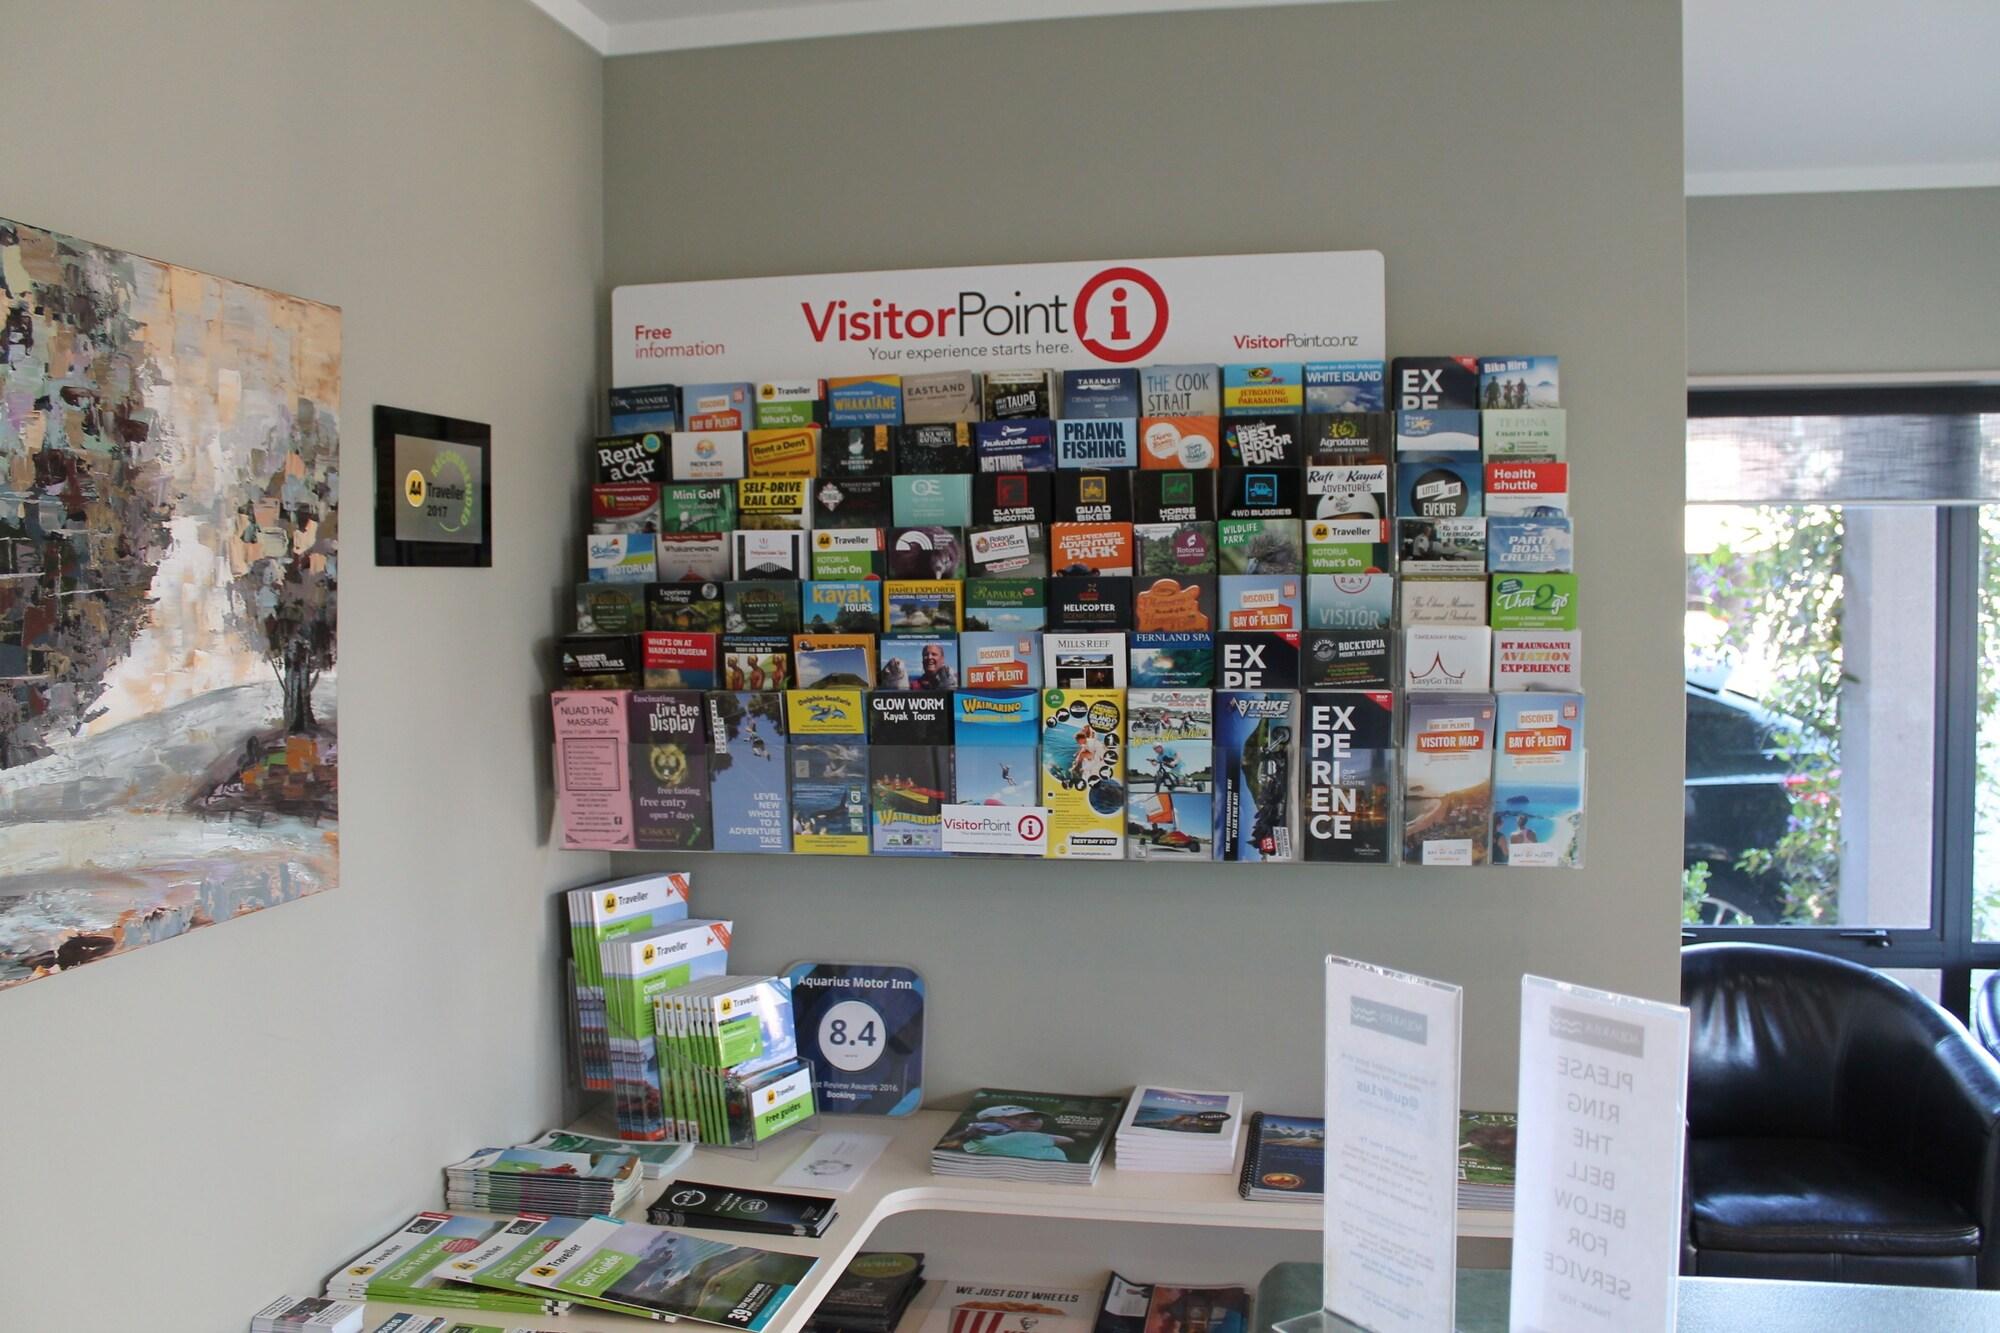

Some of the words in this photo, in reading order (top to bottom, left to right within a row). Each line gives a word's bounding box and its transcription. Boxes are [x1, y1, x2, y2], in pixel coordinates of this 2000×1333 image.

[801, 292, 1068, 342] VisitorPoint
[635, 325, 672, 340] Free
[1234, 333, 1358, 349] VisitorPoint.co.nz
[635, 342, 725, 359] information
[869, 348, 901, 361] Your
[906, 346, 988, 362] experience
[992, 342, 1031, 356] starts
[1036, 342, 1073, 355] here.
[1484, 362, 1506, 373] Bike
[1507, 361, 1528, 371] Hire
[1147, 376, 1170, 392] THE
[1176, 373, 1209, 391] COOK
[1307, 371, 1341, 383] WHITE
[1342, 371, 1381, 382] ISLAND
[1402, 369, 1443, 393] EX
[778, 386, 810, 395] Traveller
[907, 384, 965, 396] EASTLAND
[1148, 393, 1192, 411] STRAIT
[761, 415, 791, 423] What's
[792, 415, 804, 423] On
[1064, 422, 1124, 440] PRAWN
[1239, 425, 1277, 443] BEST
[784, 439, 806, 449] Dent
[1240, 434, 1292, 452] INDOOR
[1320, 437, 1369, 447] Agrodome
[599, 442, 645, 466] Rent
[1064, 440, 1127, 459] FISHING
[1242, 446, 1285, 467] FUN!
[610, 466, 621, 480] a
[622, 459, 655, 478] Car
[1494, 469, 1536, 479] Health
[1308, 471, 1334, 483] Raft
[1346, 470, 1384, 483] Kayak
[427, 482, 465, 500] Traveller
[744, 482, 801, 493] SELF-DRIVE
[1321, 483, 1372, 493] ADVENTURES
[1494, 480, 1538, 490] shuttle
[673, 489, 697, 499] Mini
[699, 489, 721, 499] Golf
[744, 495, 768, 506] RAIL
[771, 494, 797, 506] CARS
[993, 507, 1035, 515] CLAYBIRD
[1076, 505, 1112, 514] QUAD
[1160, 507, 1196, 515] HORSE
[1251, 508, 1292, 516] BUGGIES
[1423, 503, 1456, 516] EVENTS
[994, 514, 1035, 522] SHOOTING
[1224, 523, 1257, 534] WILDLIFE
[1333, 528, 1371, 536] Traveller
[834, 536, 868, 545] Traveller
[1059, 538, 1125, 549] ADVENTURE
[1223, 536, 1244, 544] PARK
[1509, 536, 1552, 544] PARTY
[1067, 546, 1118, 560] PARK
[1511, 544, 1549, 553] BOAT
[1312, 559, 1346, 567] What's
[1500, 553, 1556, 562] CRUISES
[817, 566, 846, 575] What's
[848, 566, 862, 574] On
[845, 603, 872, 612] TOURS
[1064, 604, 1115, 613] HELICOPTER
[1233, 616, 1249, 628] BAY
[1250, 615, 1260, 626] OF
[1261, 613, 1288, 625] PLENTY
[648, 639, 671, 647] WHAT'S
[1057, 639, 1087, 649] MILLS
[1087, 639, 1110, 648] REEF
[1136, 633, 1190, 643] FERNLAND
[1193, 633, 1210, 642] SPA
[1339, 639, 1385, 650] ROCKTOPIA
[648, 647, 676, 655] WAIKATO
[678, 648, 707, 657] MUSEUM
[980, 650, 1010, 659] DISCOVER
[1224, 644, 1266, 669] EX
[1502, 652, 1570, 661] AVIATION
[1501, 664, 1571, 673] EXPERIENCE
[970, 673, 986, 683] BAY
[988, 672, 996, 681] OF
[997, 669, 1024, 681] PLENTY
[561, 707, 588, 715] NUAD
[680, 704, 699, 717] Bee
[873, 699, 905, 711] GLOW
[908, 699, 944, 710] WORM
[1248, 701, 1290, 711] TRIKE
[567, 718, 609, 726] MASSAGE
[649, 713, 696, 734] Display
[883, 712, 908, 724] Kayak
[914, 712, 935, 721] Tours
[1312, 706, 1356, 731] EX
[1520, 714, 1553, 723] DISCOVER
[1312, 733, 1351, 758] PE
[1421, 736, 1456, 748] VISITOR
[1458, 735, 1479, 745] MAP
[1509, 737, 1522, 748] BAY
[1526, 737, 1536, 746] OF
[1537, 735, 1566, 746] PLENTY
[1312, 761, 1339, 785] RI
[657, 787, 672, 795] free
[640, 798, 657, 807] free
[659, 799, 687, 809] entry
[1312, 788, 1356, 812] EN
[676, 812, 695, 820] days
[748, 810, 781, 818] WHOLE
[1310, 815, 1352, 840] CE
[760, 836, 782, 844] TAKE
[618, 892, 648, 905] Traveller
[657, 942, 688, 956] Traveller
[798, 976, 850, 988] Aquarius
[853, 978, 889, 989] Motor
[892, 979, 912, 989] Inn
[830, 1019, 876, 1047] 8.4
[880, 1084, 898, 1092] 2016
[765, 1110, 780, 1124] Free
[780, 1102, 801, 1120] guides
[366, 1244, 402, 1266] Traveller
[471, 1245, 503, 1263] Traveller
[554, 1242, 582, 1268] Traveller
[576, 1272, 594, 1288] Golf
[592, 1254, 623, 1276] Guide
[956, 1285, 973, 1296] WE
[975, 1287, 1004, 1298] JUST
[1004, 1290, 1029, 1300] GOT
[1030, 1291, 1079, 1304] WHEELS
[728, 1308, 753, 1323] 39
